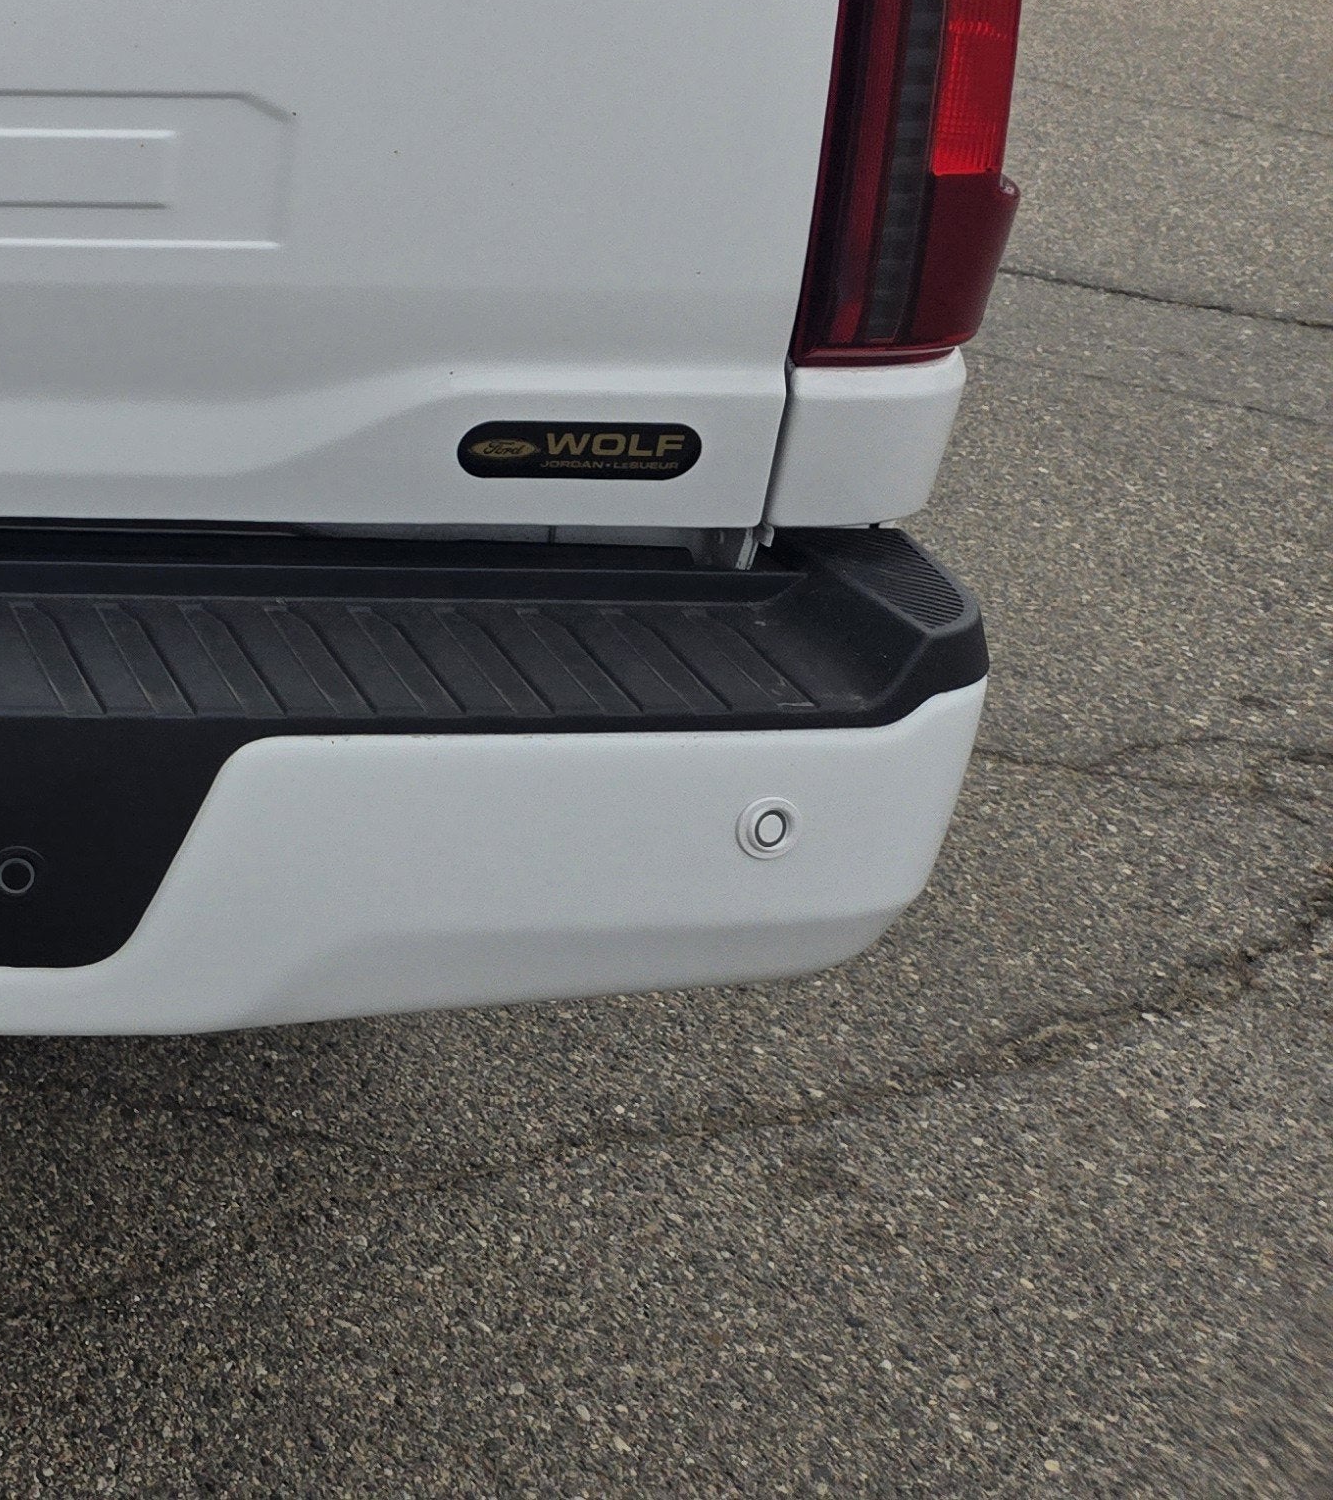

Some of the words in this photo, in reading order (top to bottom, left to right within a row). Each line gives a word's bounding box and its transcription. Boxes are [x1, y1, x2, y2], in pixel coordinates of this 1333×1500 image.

[483, 441, 526, 455] Ford
[545, 432, 686, 457] WOLF
[540, 460, 604, 469] JORDAN
